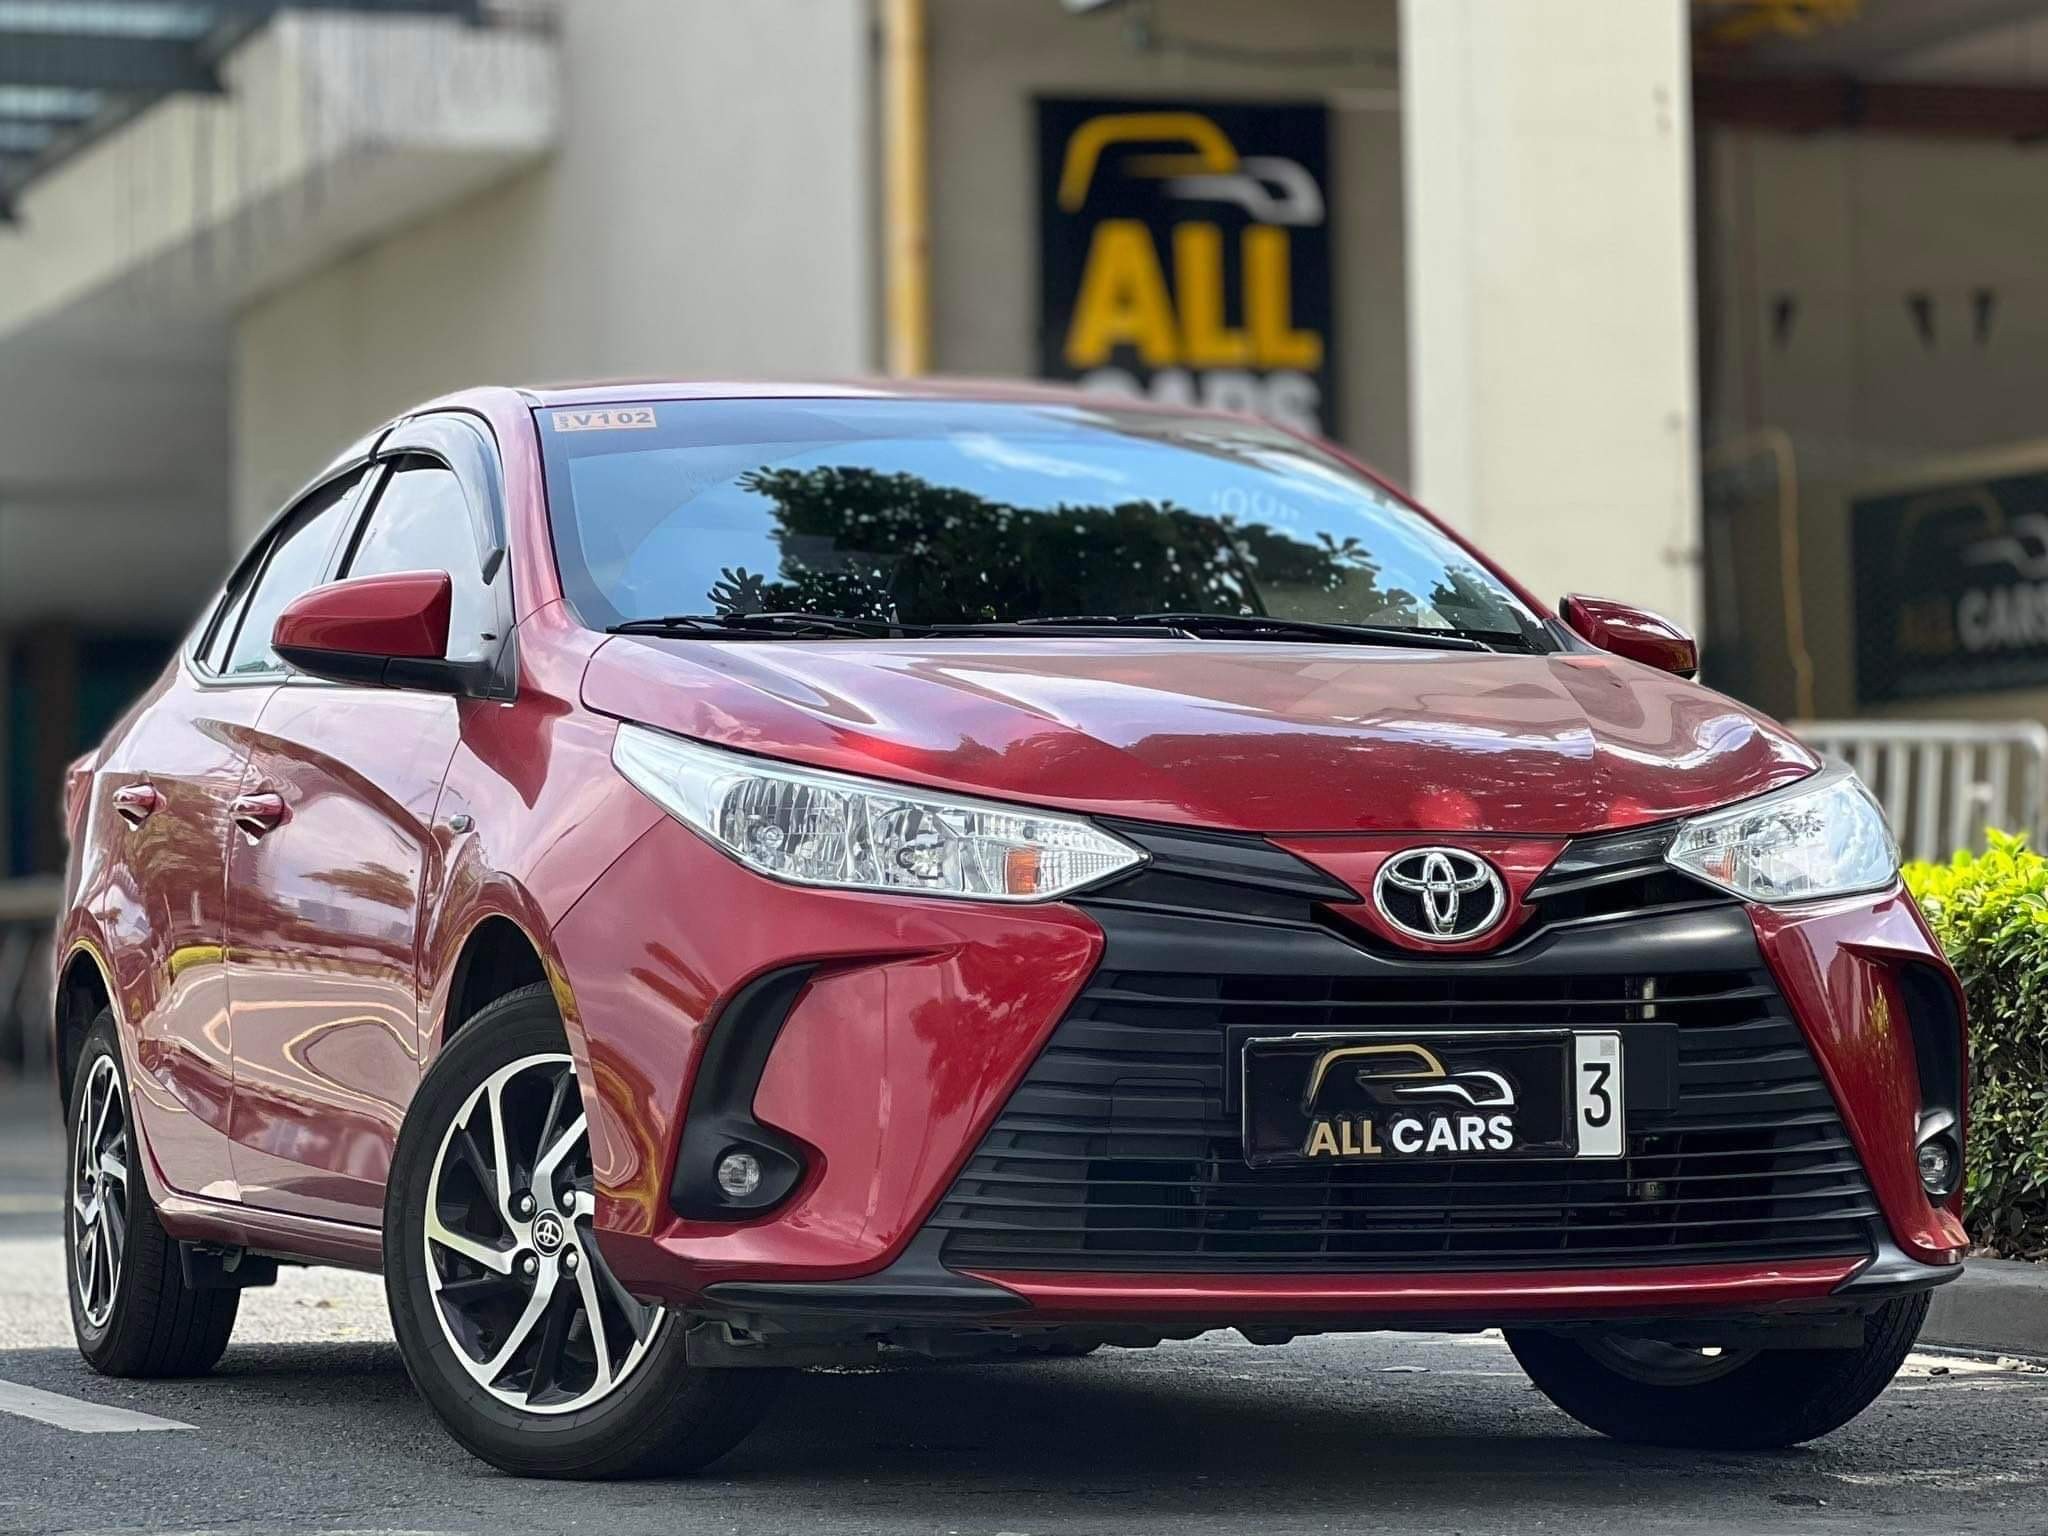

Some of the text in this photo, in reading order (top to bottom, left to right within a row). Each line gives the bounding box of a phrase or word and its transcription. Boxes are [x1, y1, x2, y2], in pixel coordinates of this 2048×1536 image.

[1065, 217, 1324, 367] ALL
[1583, 1062, 1612, 1128] 3
[1309, 1115, 1514, 1156] ALL CARS
